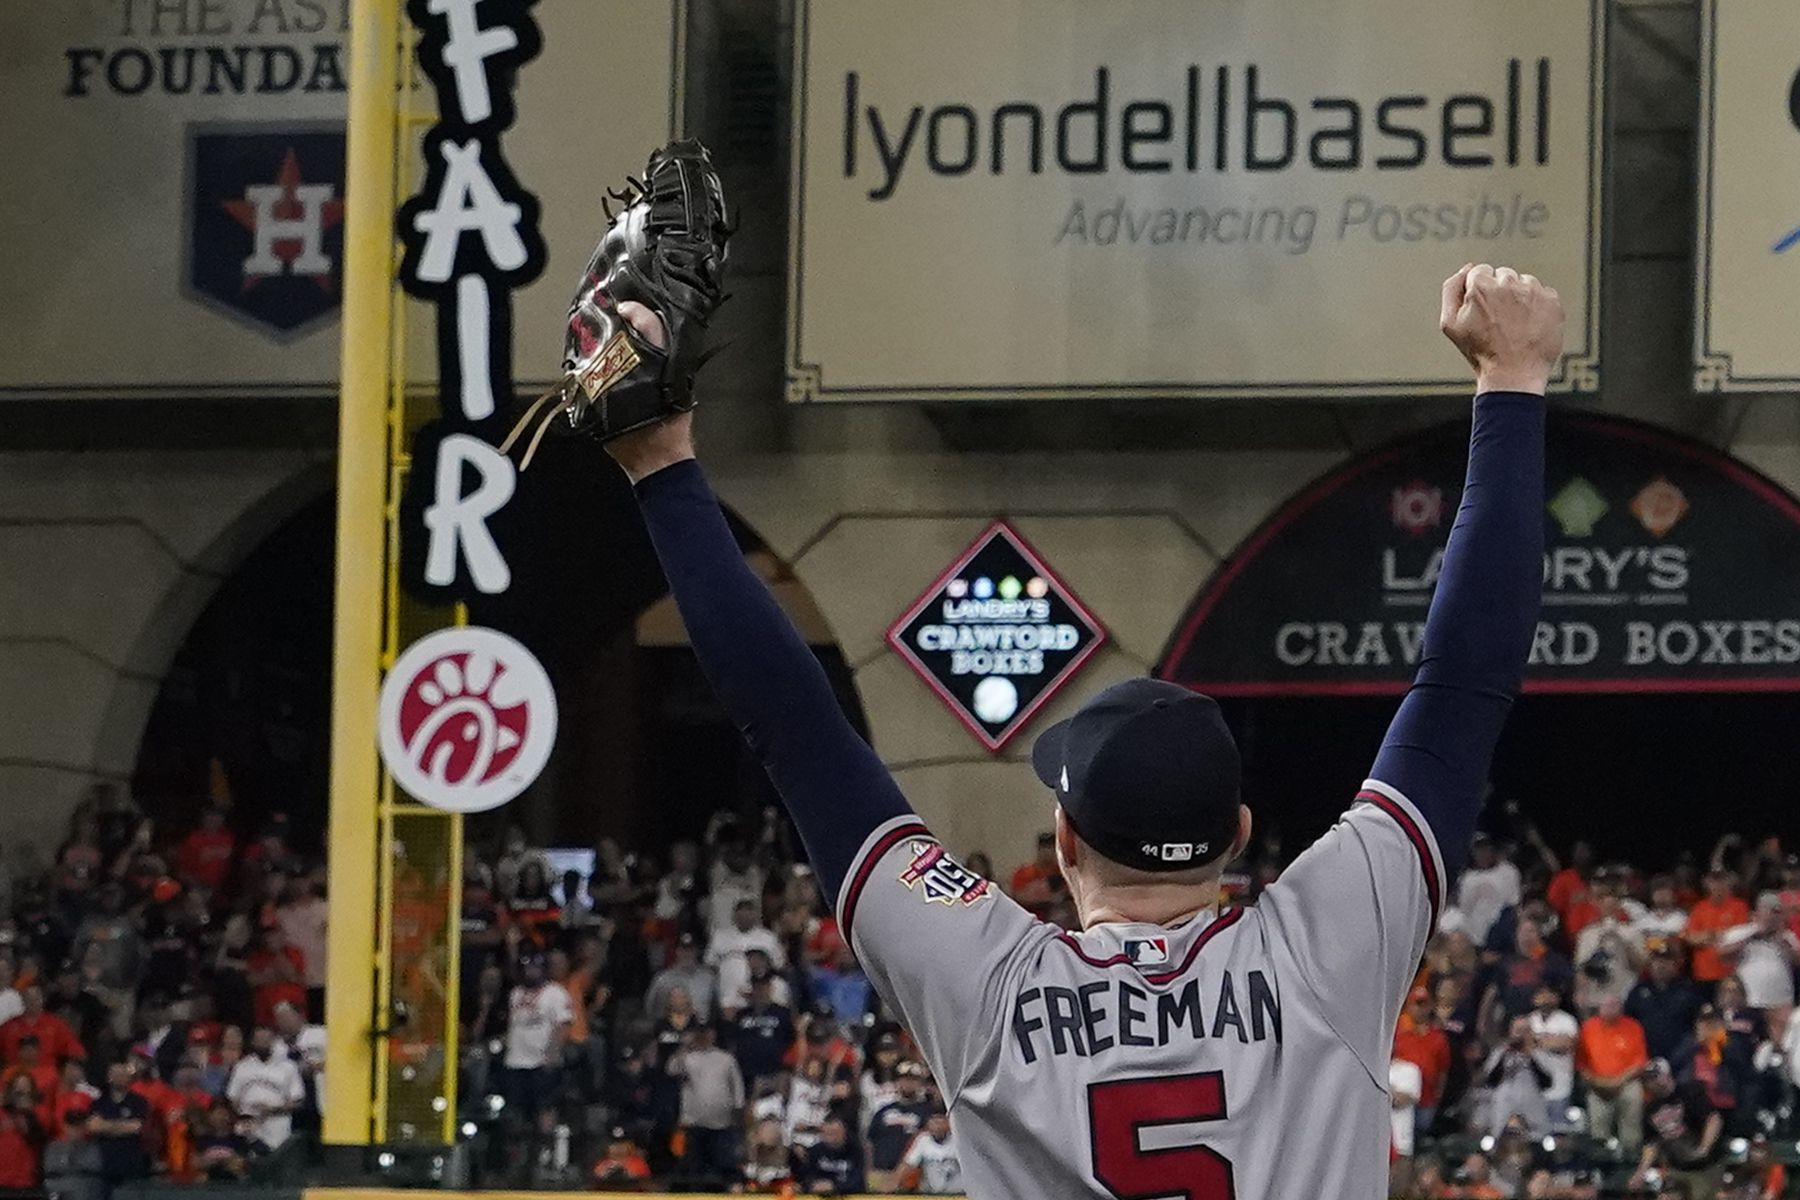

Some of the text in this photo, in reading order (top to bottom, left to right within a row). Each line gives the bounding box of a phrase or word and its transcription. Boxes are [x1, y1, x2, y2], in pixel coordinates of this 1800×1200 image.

[843, 57, 1552, 201] lyondellbasell
[1054, 195, 1550, 256] Advancing Possible
[412, 0, 527, 596] FAIR
[916, 624, 1079, 651] CRAWFORD
[943, 600, 1050, 620] LANDRY'S
[951, 650, 1045, 675] BOXES
[1012, 970, 1282, 1065] FREEMAN
